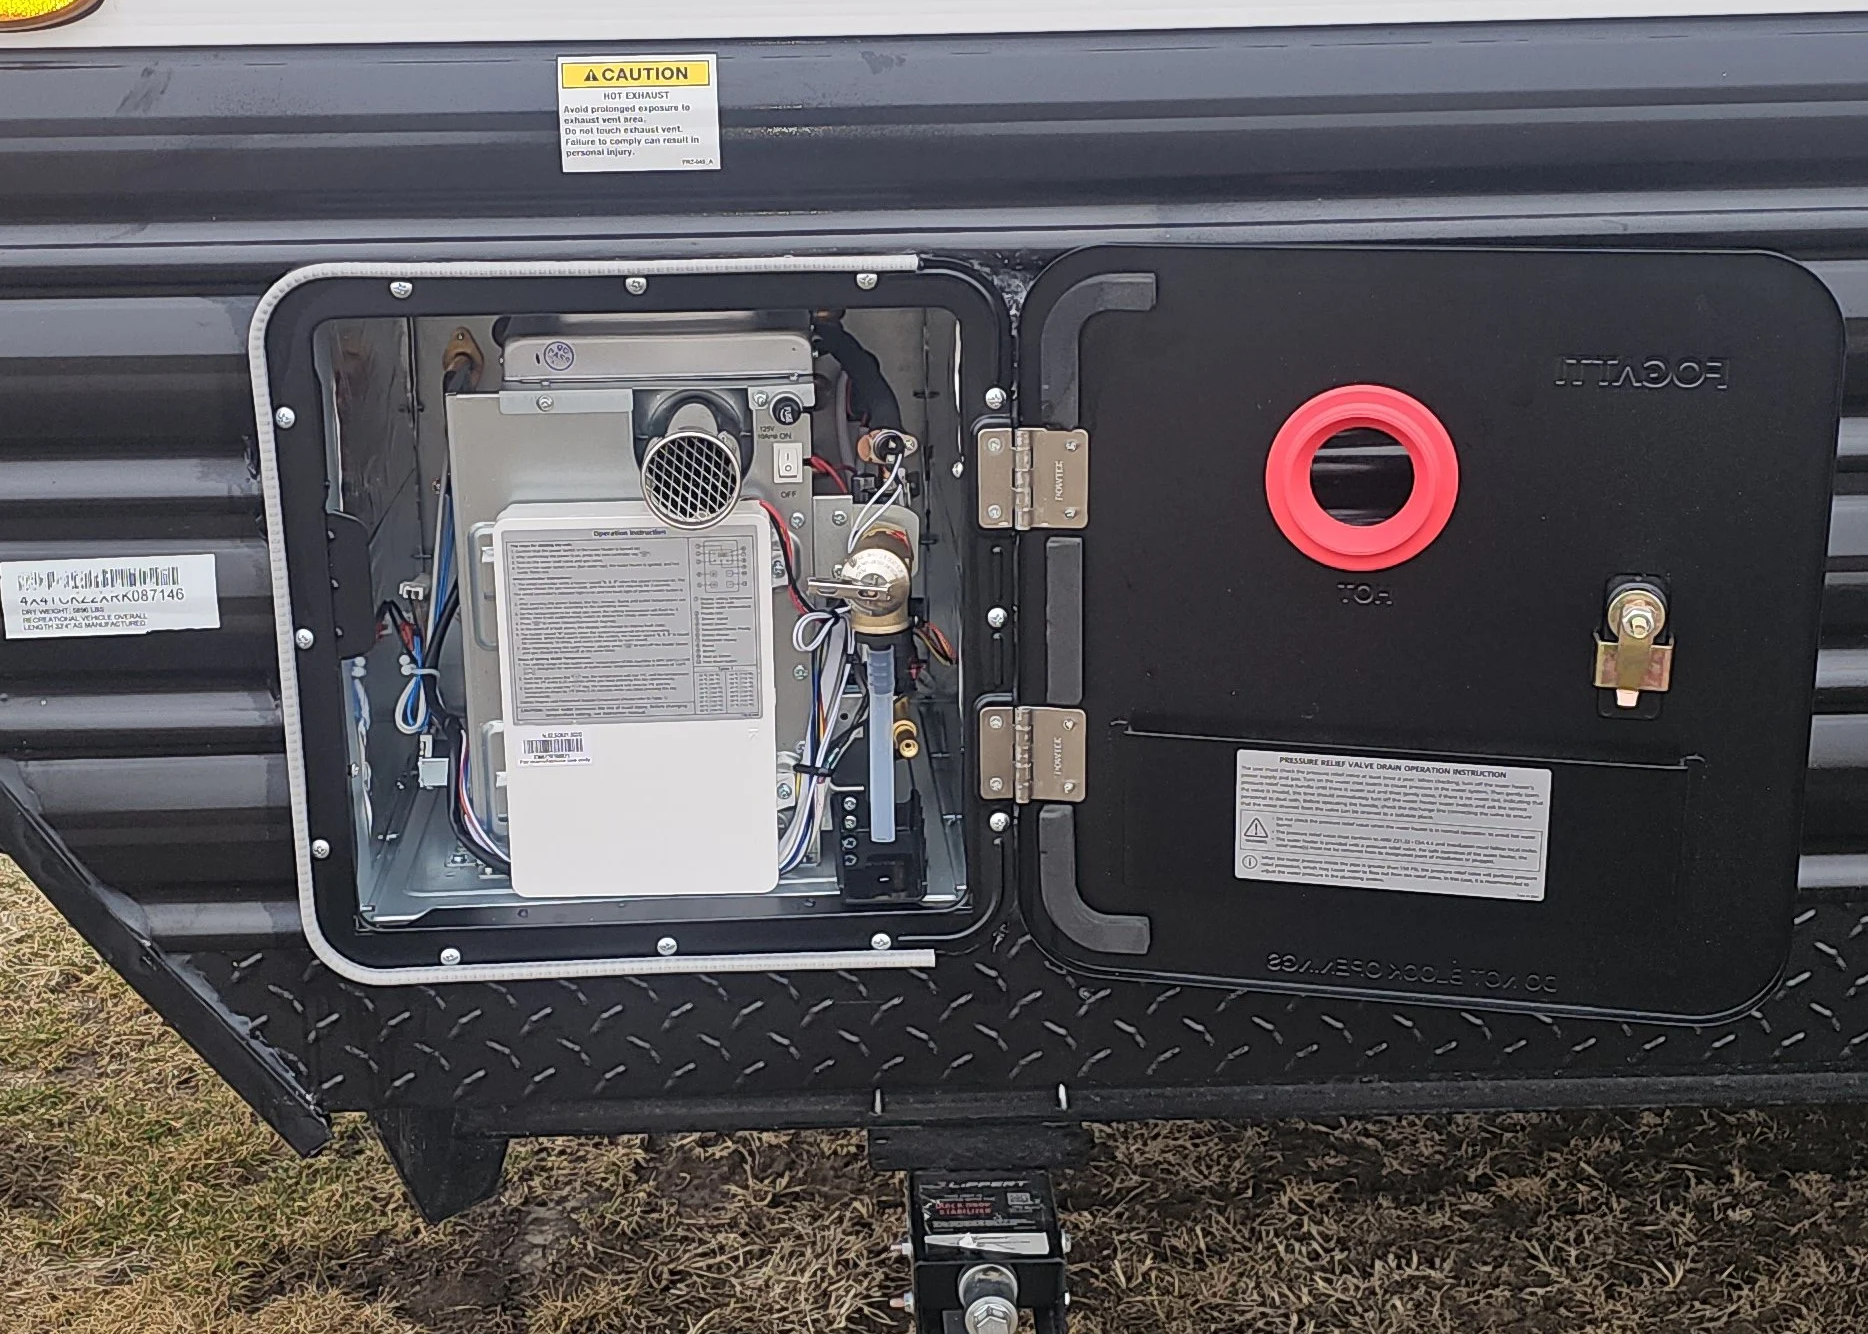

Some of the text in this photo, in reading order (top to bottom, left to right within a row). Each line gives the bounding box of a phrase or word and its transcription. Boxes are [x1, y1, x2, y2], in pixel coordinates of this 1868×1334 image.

[602, 67, 688, 82] CAUTION
[604, 91, 670, 100] HOT EXHAUST
[563, 104, 690, 114] Avoid prolonged exposure to
[564, 116, 647, 124] exhaust vent area.
[565, 127, 577, 135] Do
[579, 127, 594, 135] not
[596, 126, 621, 135] touch
[624, 126, 659, 134] exhaust
[565, 136, 700, 147] Failure to comply can result in
[566, 147, 636, 158] personal injury.
[21, 608, 37, 616] DRY
[22, 612, 147, 624] RECREATIONAL VEHICLE OVERALL
[84, 620, 146, 629] MANUFACTURED
[1279, 756, 1507, 778] PRESSURE RELIEF VALVE DRAIN OPERATION INSTRUCTION
